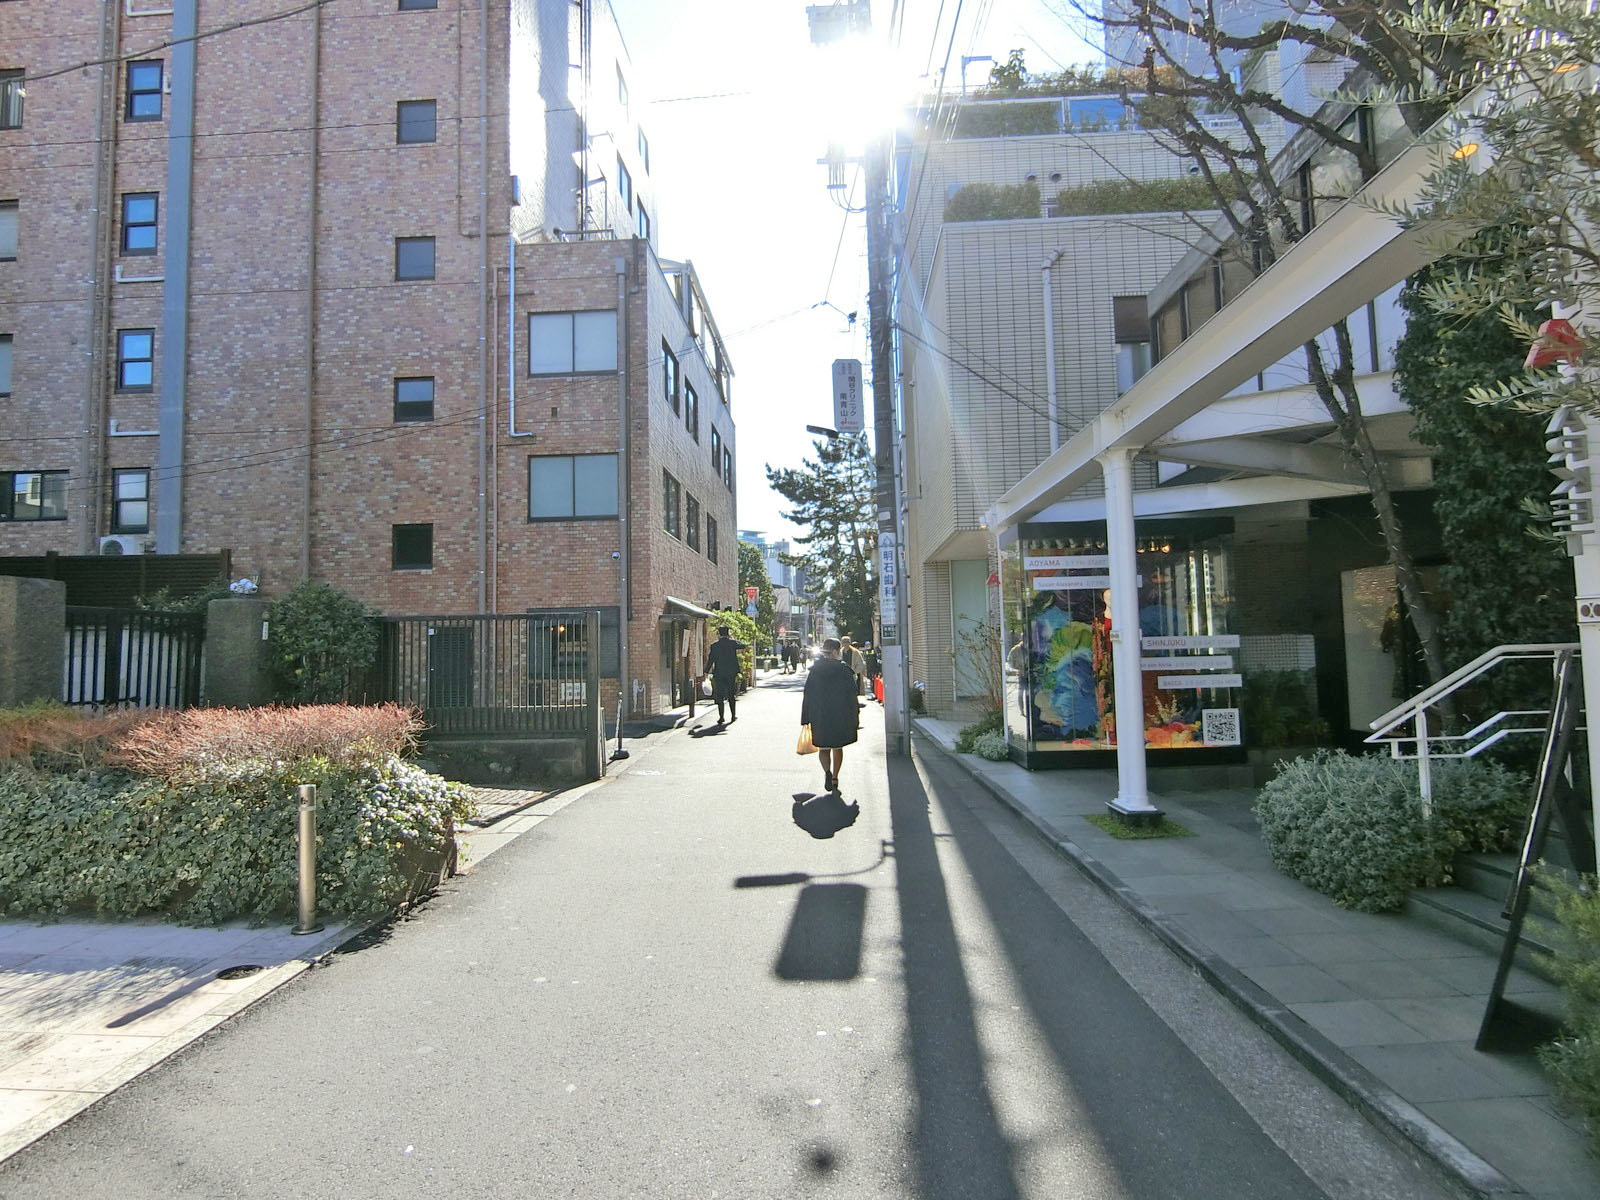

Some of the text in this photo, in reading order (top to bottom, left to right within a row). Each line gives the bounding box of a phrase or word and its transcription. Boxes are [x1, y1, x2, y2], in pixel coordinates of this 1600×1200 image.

[1028, 559, 1061, 567] AOYAMA
[883, 551, 896, 596] 明石歯科
[1146, 639, 1187, 647] SHINJUKU
